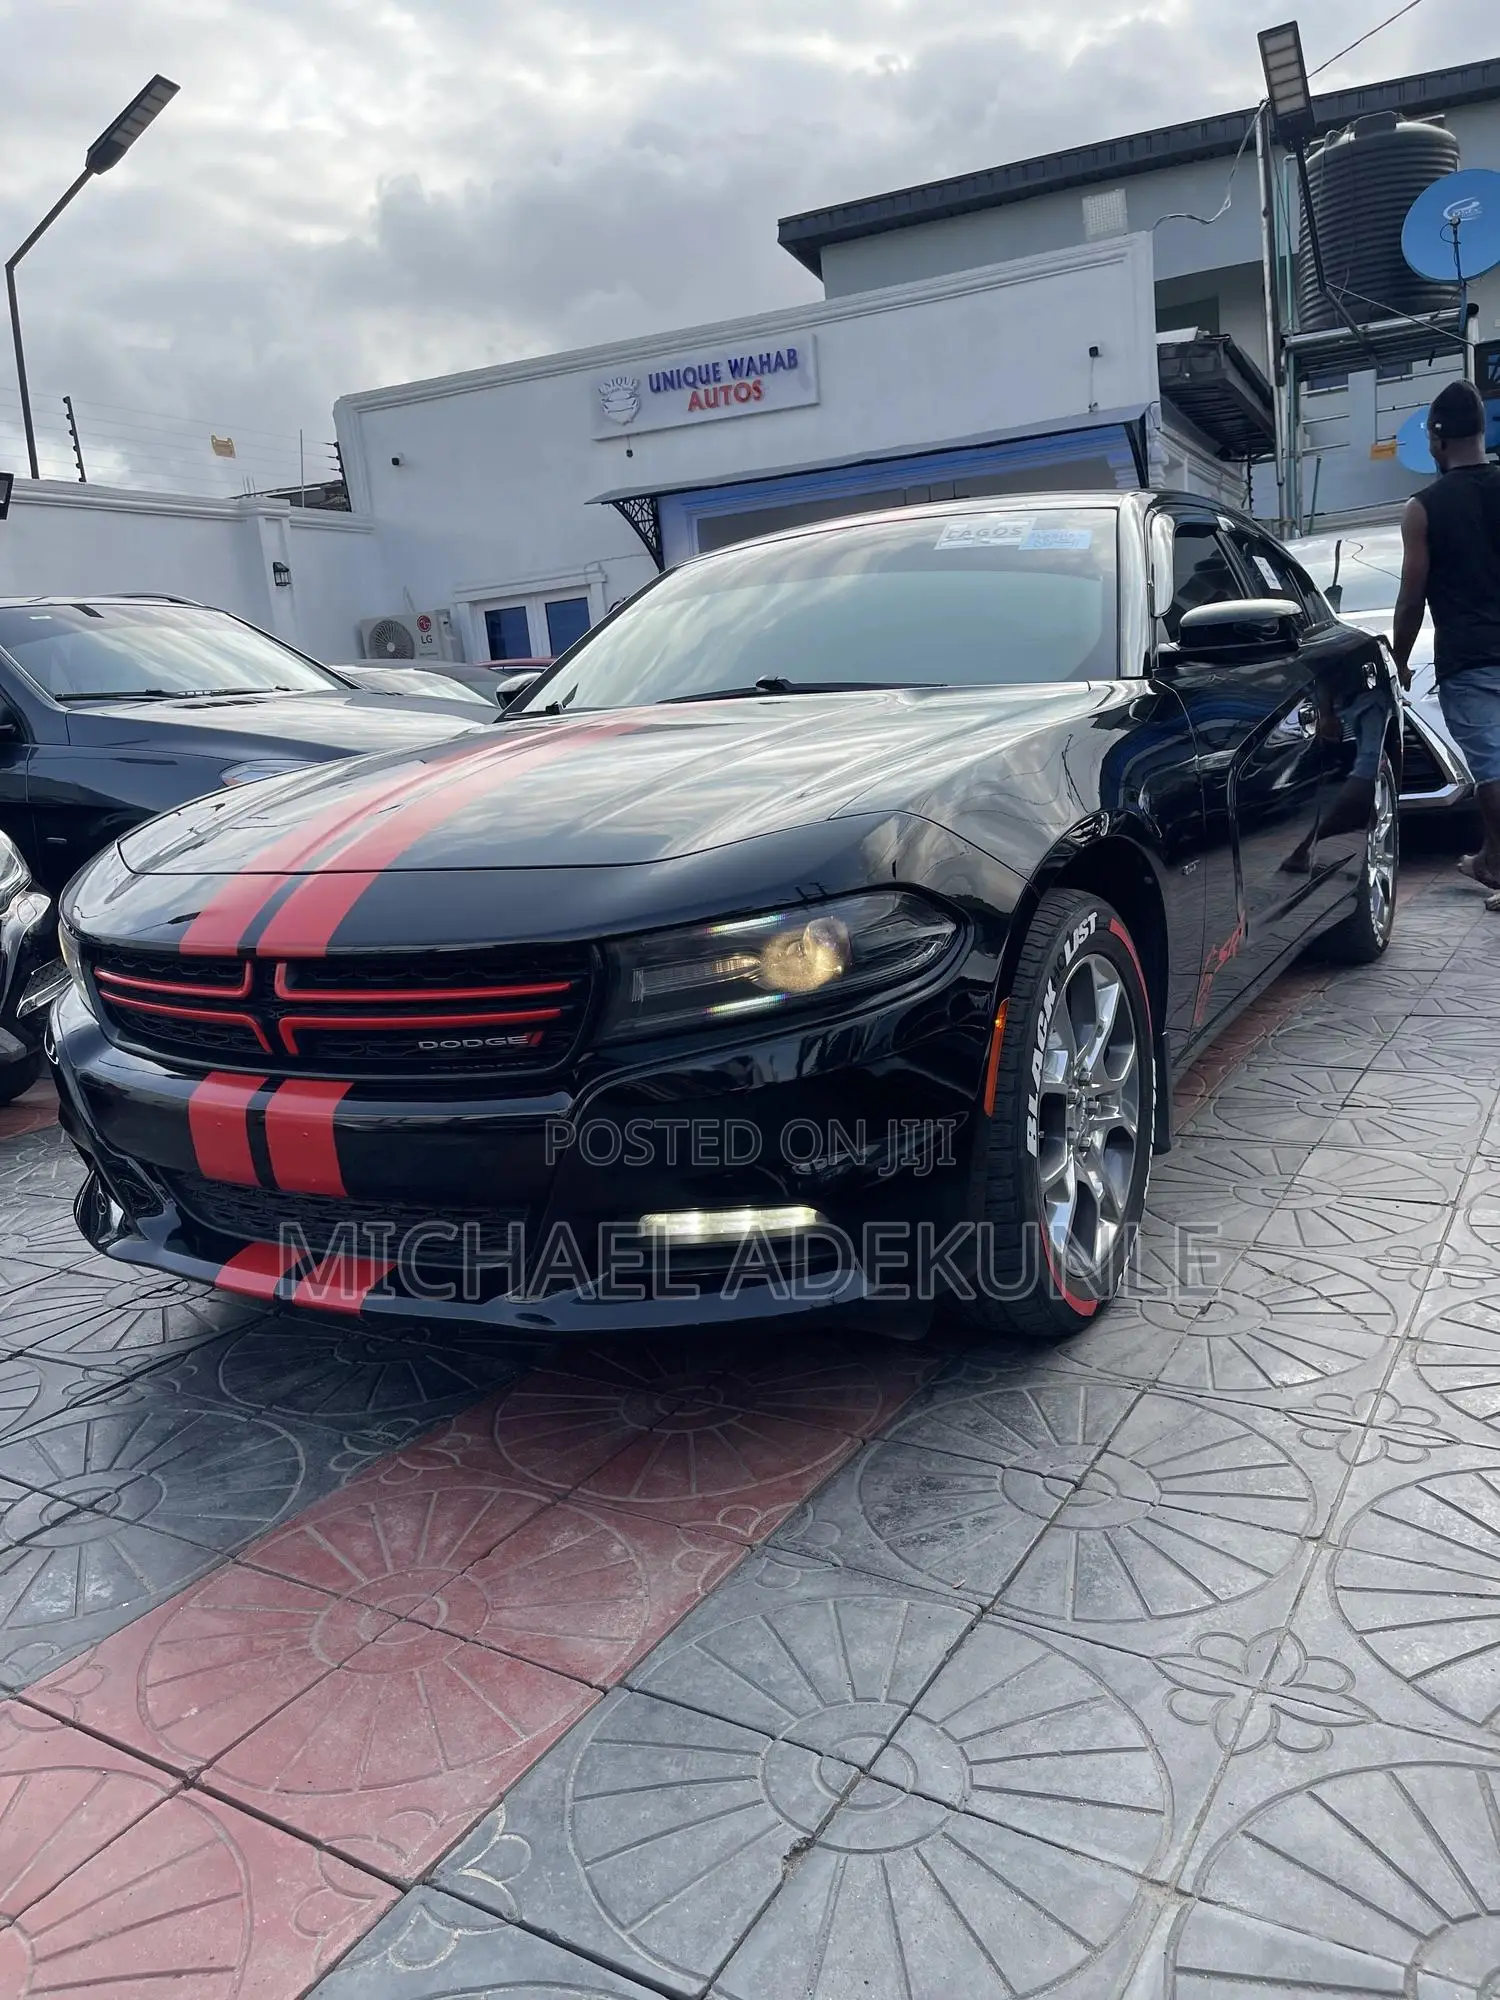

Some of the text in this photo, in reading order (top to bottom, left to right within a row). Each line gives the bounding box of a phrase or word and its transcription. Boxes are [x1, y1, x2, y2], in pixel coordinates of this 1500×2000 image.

[648, 348, 799, 394] UNIQUE WAHAB
[687, 379, 764, 413] AUTOS
[420, 634, 433, 644] LG
[418, 1035, 529, 1049] DODGE
[1026, 976, 1057, 1158] BLACK
